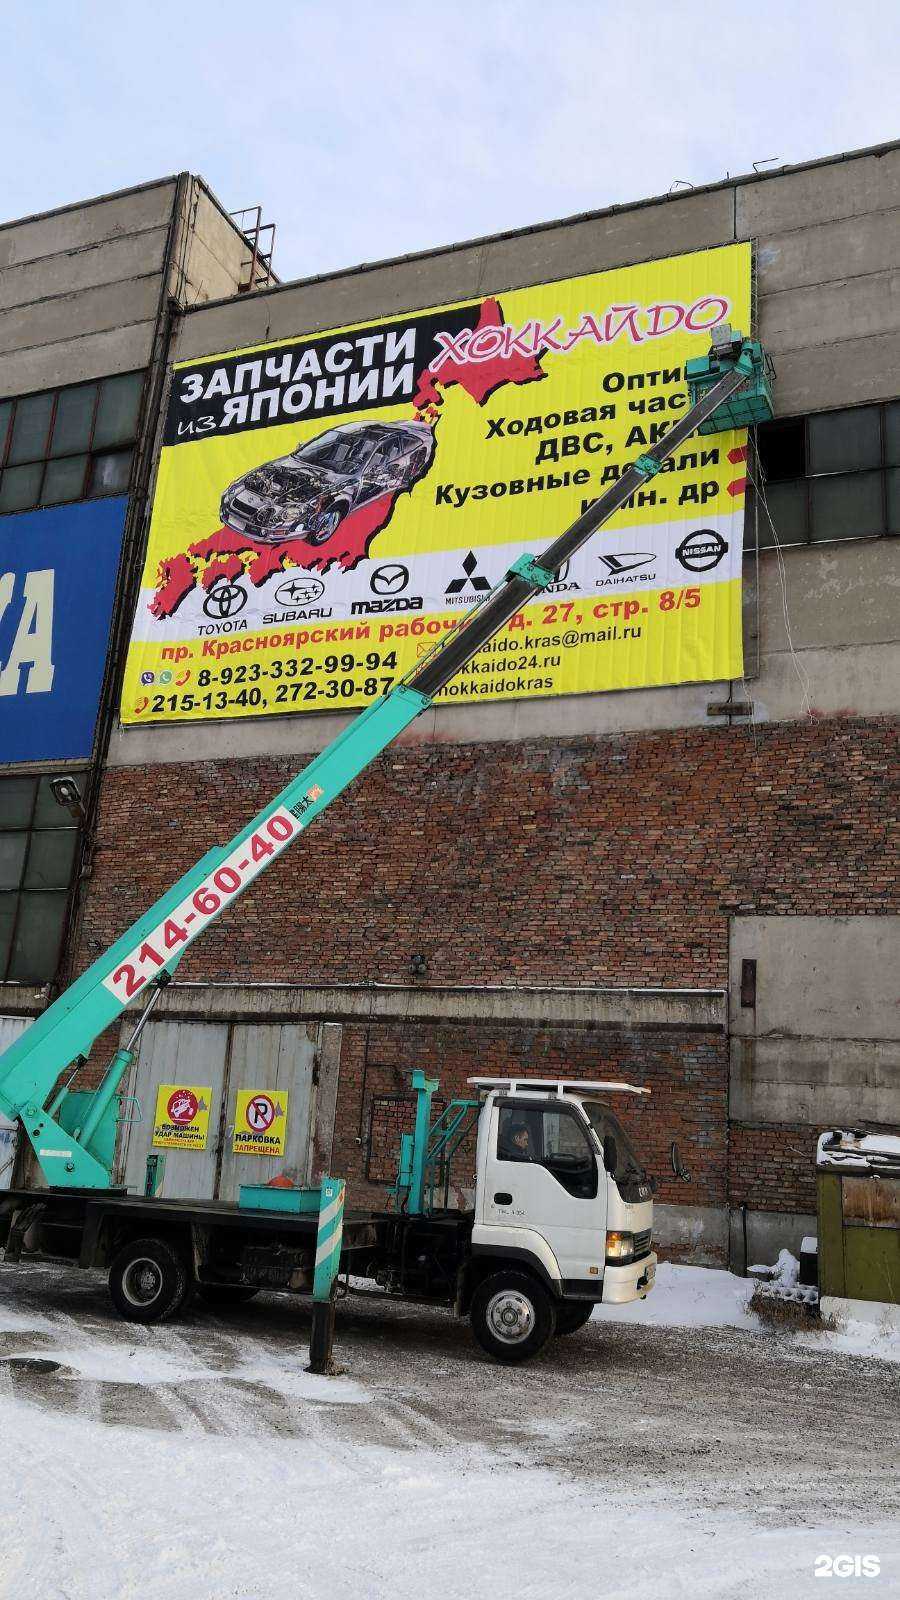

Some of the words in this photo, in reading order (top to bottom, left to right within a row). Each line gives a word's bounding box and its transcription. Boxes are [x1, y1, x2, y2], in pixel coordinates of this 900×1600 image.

[428, 296, 731, 372] ХОККАЙДО
[180, 328, 417, 404] ЗАПЧАСТИ
[602, 366, 687, 393] Опти
[177, 415, 217, 436] из
[219, 362, 415, 428] ЯПОНИИ
[485, 404, 616, 440] Ходовая
[628, 390, 692, 415] час
[534, 432, 613, 465] ДВС,
[624, 419, 702, 448] АК
[435, 468, 591, 508] Кузовные
[600, 448, 720, 486] деали
[678, 480, 720, 506] др
[682, 544, 722, 557] NISSAN
[541, 581, 582, 594] NDA
[595, 573, 657, 587] DAIHATSU
[445, 593, 491, 605] MITSUBIS
[161, 646, 194, 664] пр.
[202, 621, 371, 660] Красноярский
[379, 616, 472, 643] рабоч
[508, 613, 533, 632] д.
[542, 602, 584, 625] 27,
[592, 598, 649, 622] стр.
[659, 588, 701, 611] 8/5
[197, 619, 248, 637] TOYOTA
[262, 607, 333, 625] SUBARU
[477, 626, 642, 654] aido.kras@mail.ru
[197, 651, 398, 688] 8-923-332-99-94
[459, 656, 561, 676] kkaido24.ru
[151, 687, 268, 713] 215-13-40,
[275, 677, 395, 703] 272-30-87
[112, 815, 294, 998] 214-60-40
[154, 1130, 172, 1138] УДАР
[235, 1133, 281, 1144] ПАРКОВКА
[234, 1144, 280, 1154] ЗАПРЕЩЕНА
